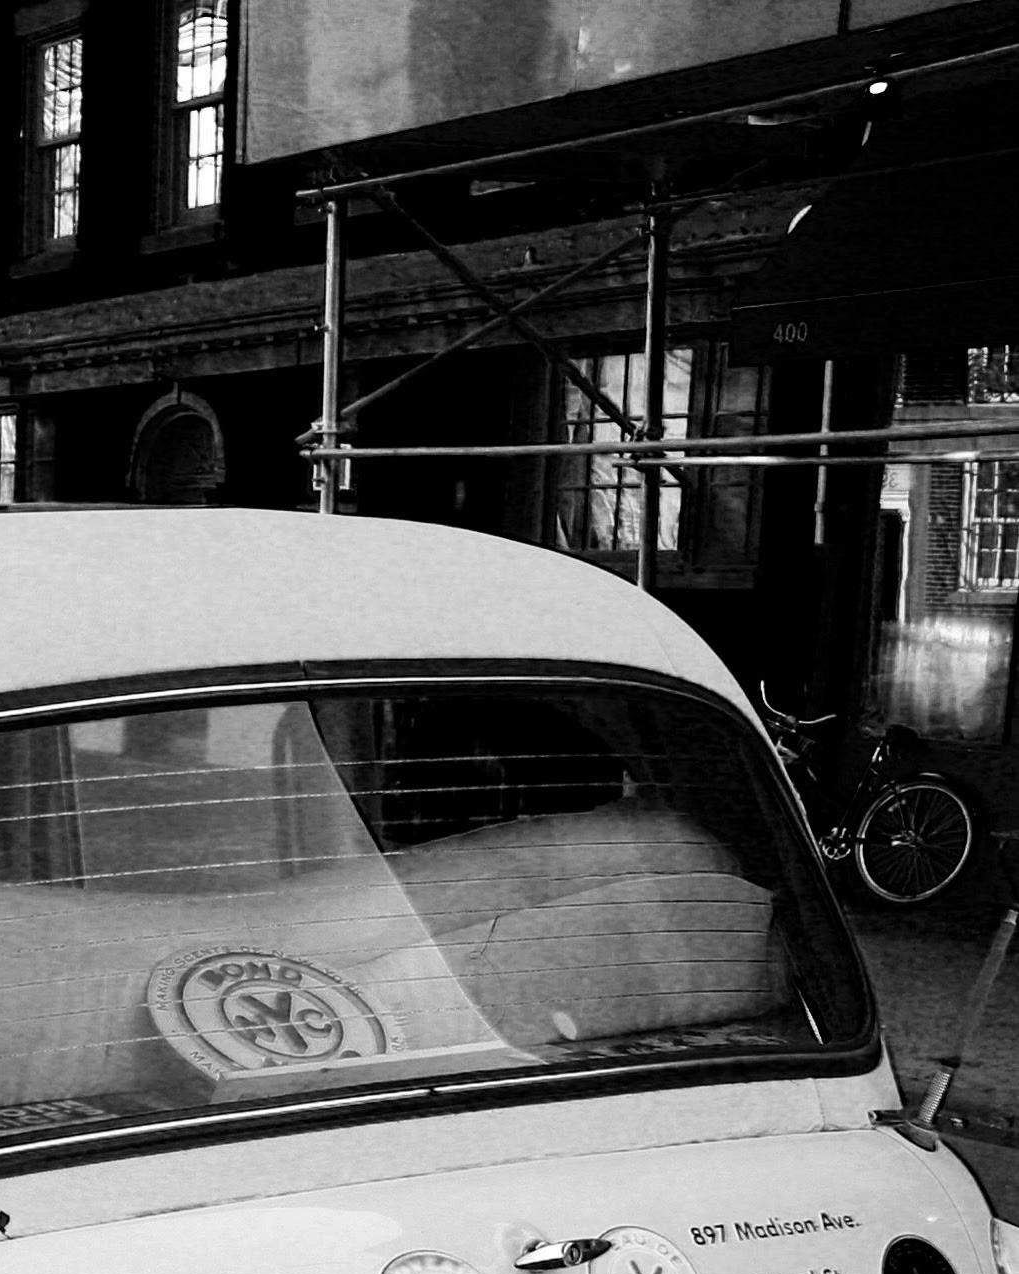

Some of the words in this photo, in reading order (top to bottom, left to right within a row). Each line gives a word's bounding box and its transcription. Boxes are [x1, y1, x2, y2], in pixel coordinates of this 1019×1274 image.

[772, 321, 808, 344] 400
[156, 967, 176, 1012] MAKING
[199, 961, 303, 988] BOND
[232, 991, 333, 1054] NYC
[690, 1223, 726, 1246] 897
[733, 1217, 818, 1241] Madison
[820, 1211, 861, 1231] Ave.
